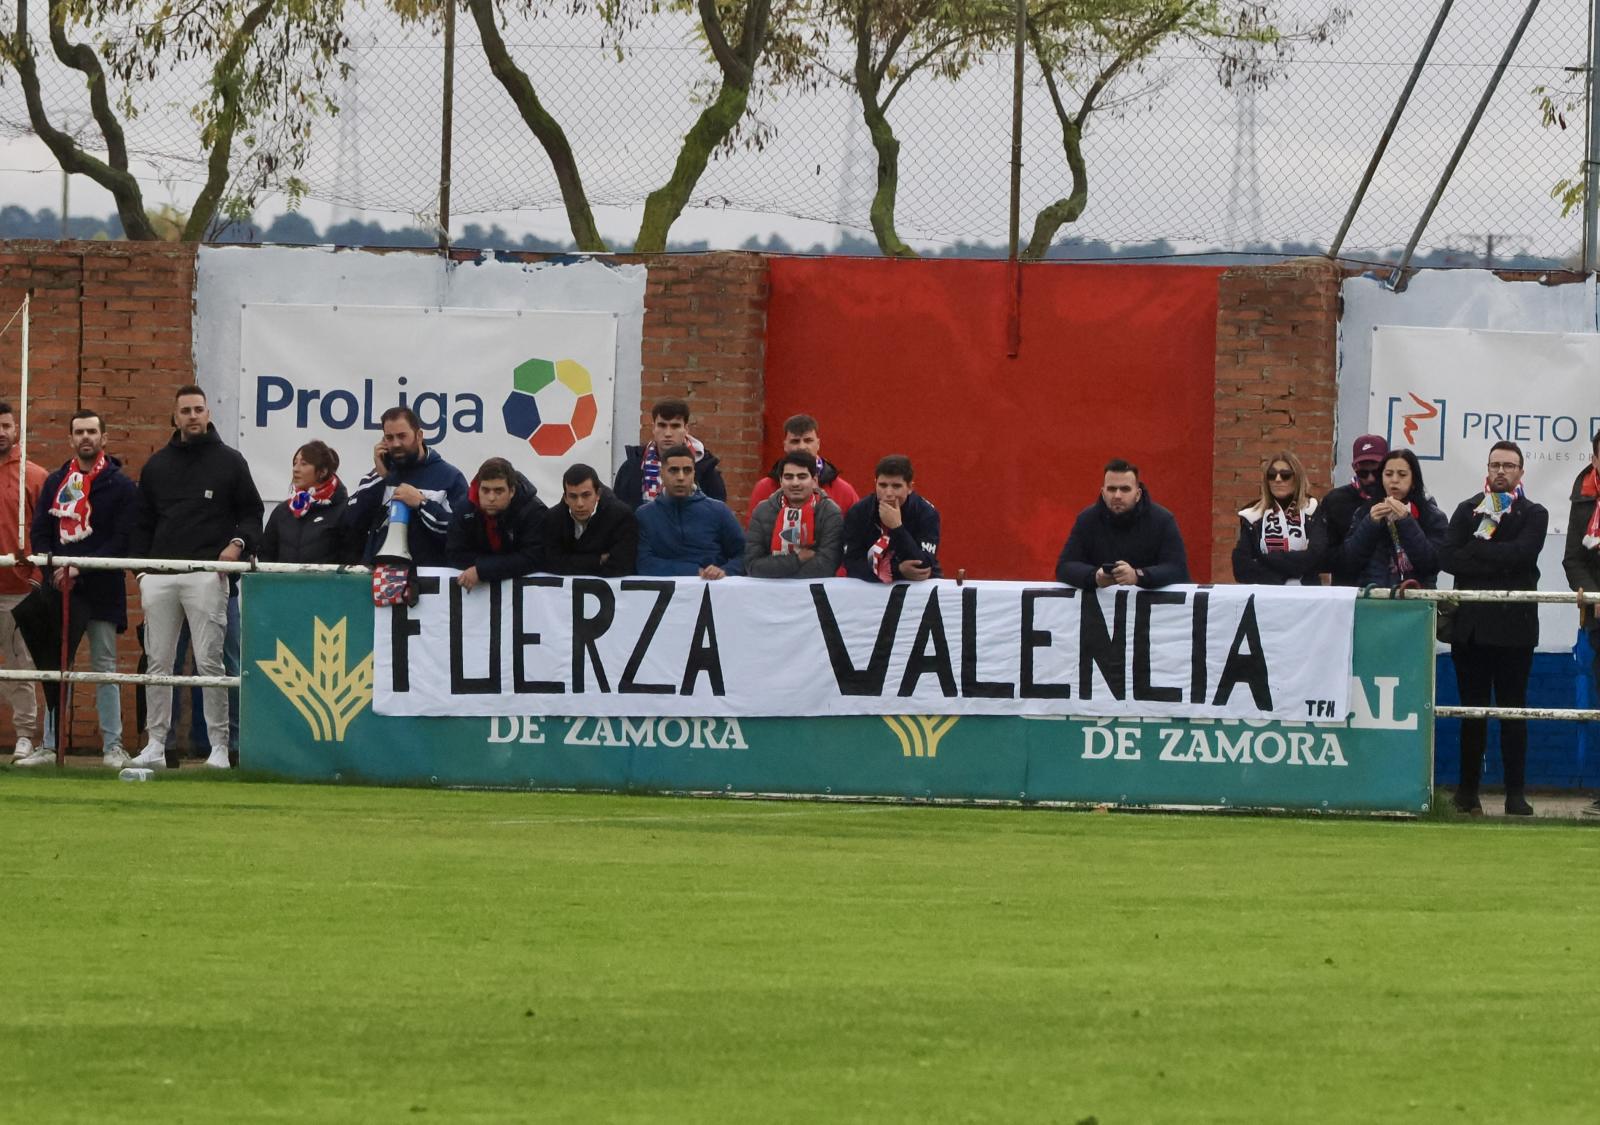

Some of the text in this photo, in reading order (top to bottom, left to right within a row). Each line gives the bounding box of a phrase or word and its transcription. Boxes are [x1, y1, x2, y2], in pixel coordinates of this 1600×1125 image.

[256, 375, 484, 445] ProLiga
[1463, 412, 1578, 442] PRIETO
[392, 576, 726, 697] FUERZA
[487, 715, 749, 750] DE ZAMORA
[1081, 727, 1348, 767] DE ZAMORA
